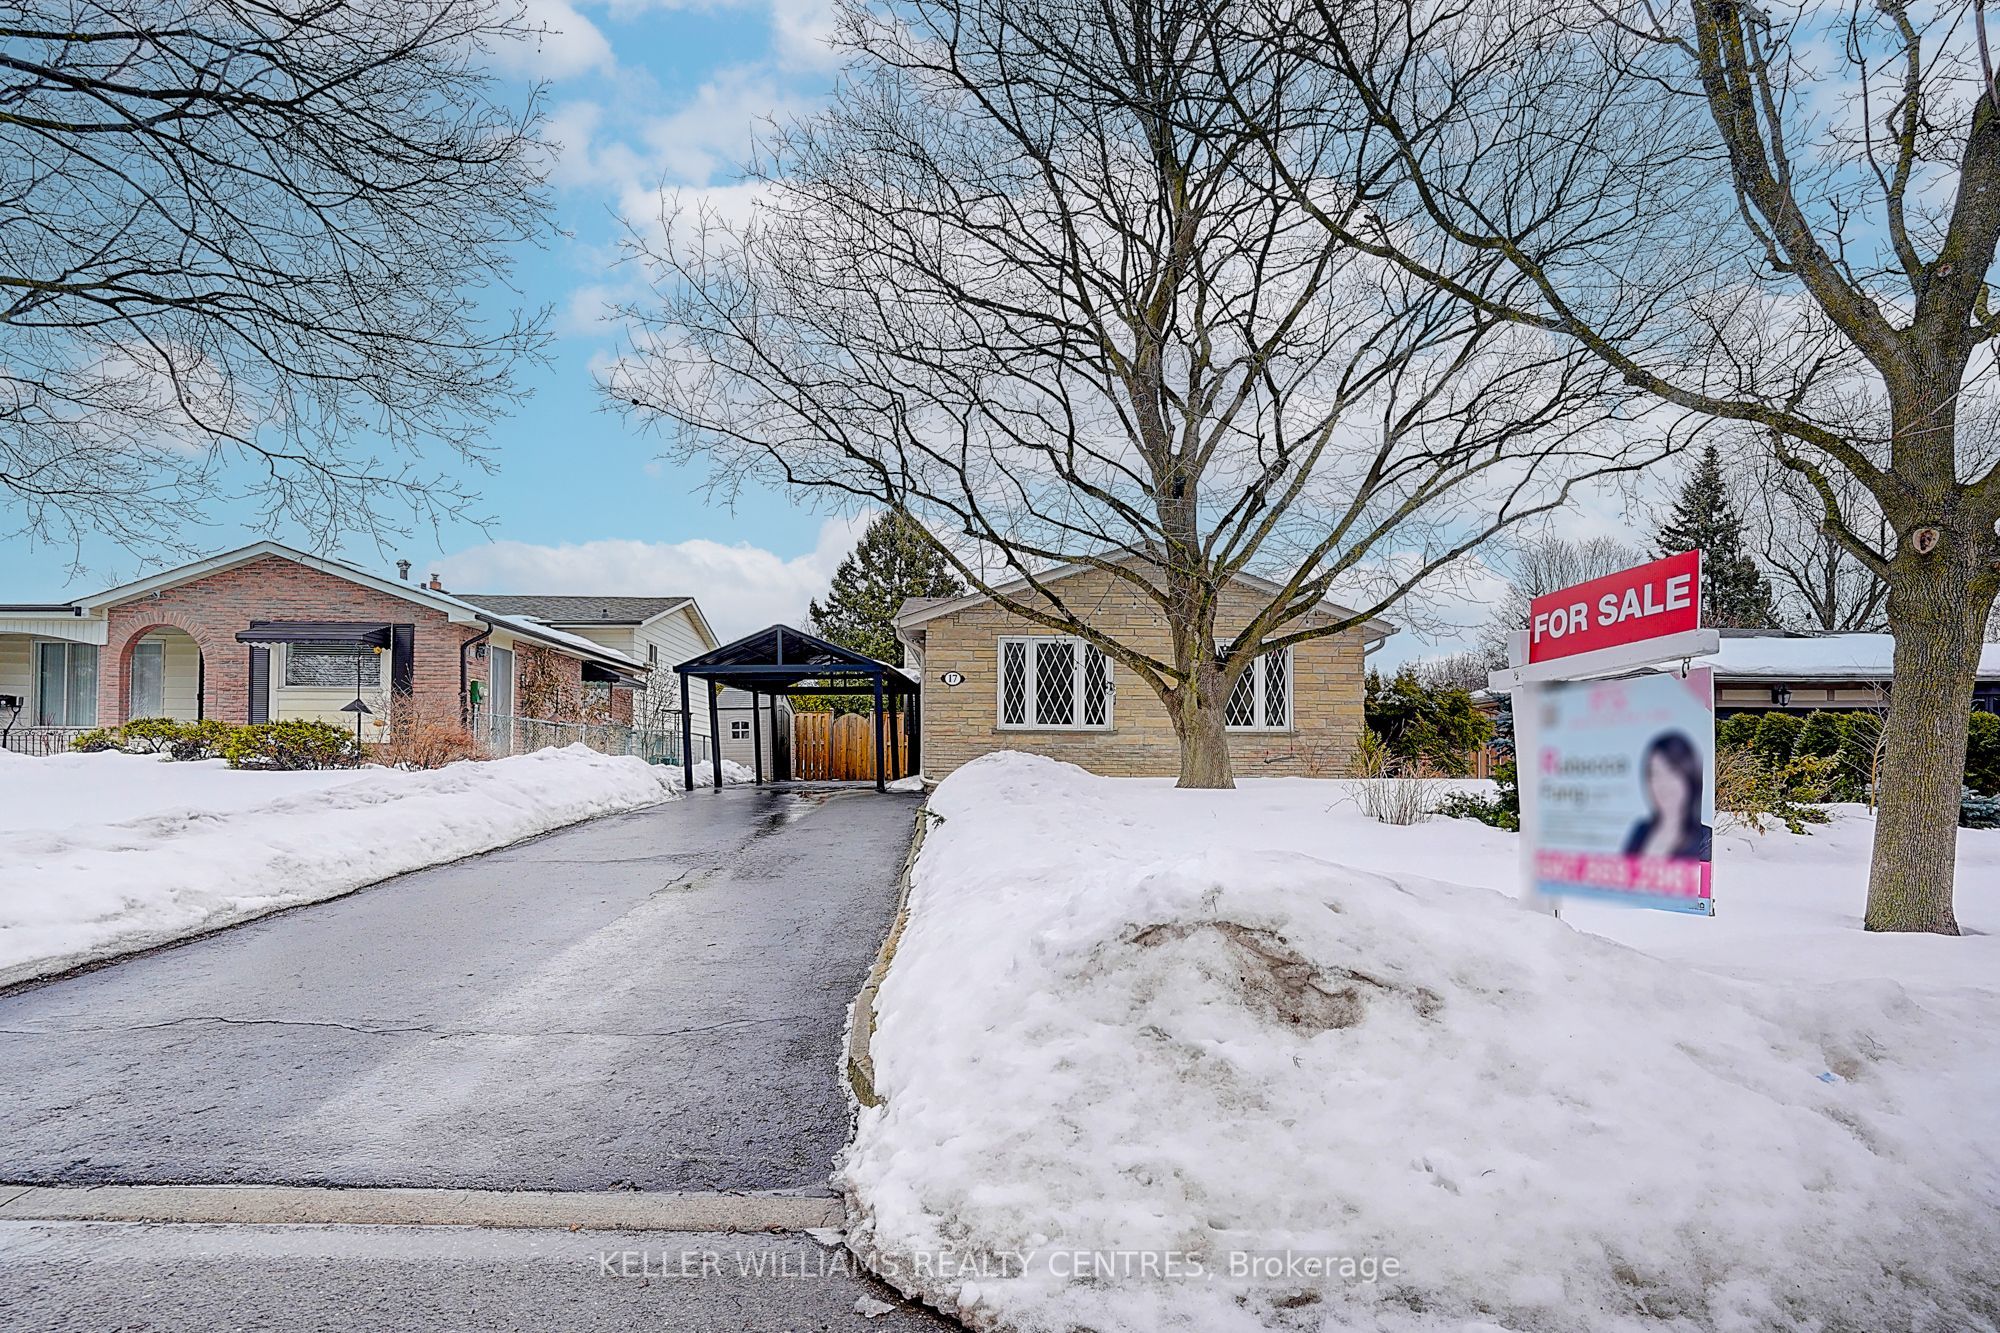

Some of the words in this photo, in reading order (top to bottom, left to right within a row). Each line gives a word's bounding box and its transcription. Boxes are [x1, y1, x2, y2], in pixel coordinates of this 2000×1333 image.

[1534, 602, 1588, 643] FOR
[1598, 574, 1690, 626] SALE
[948, 674, 958, 683] 17
